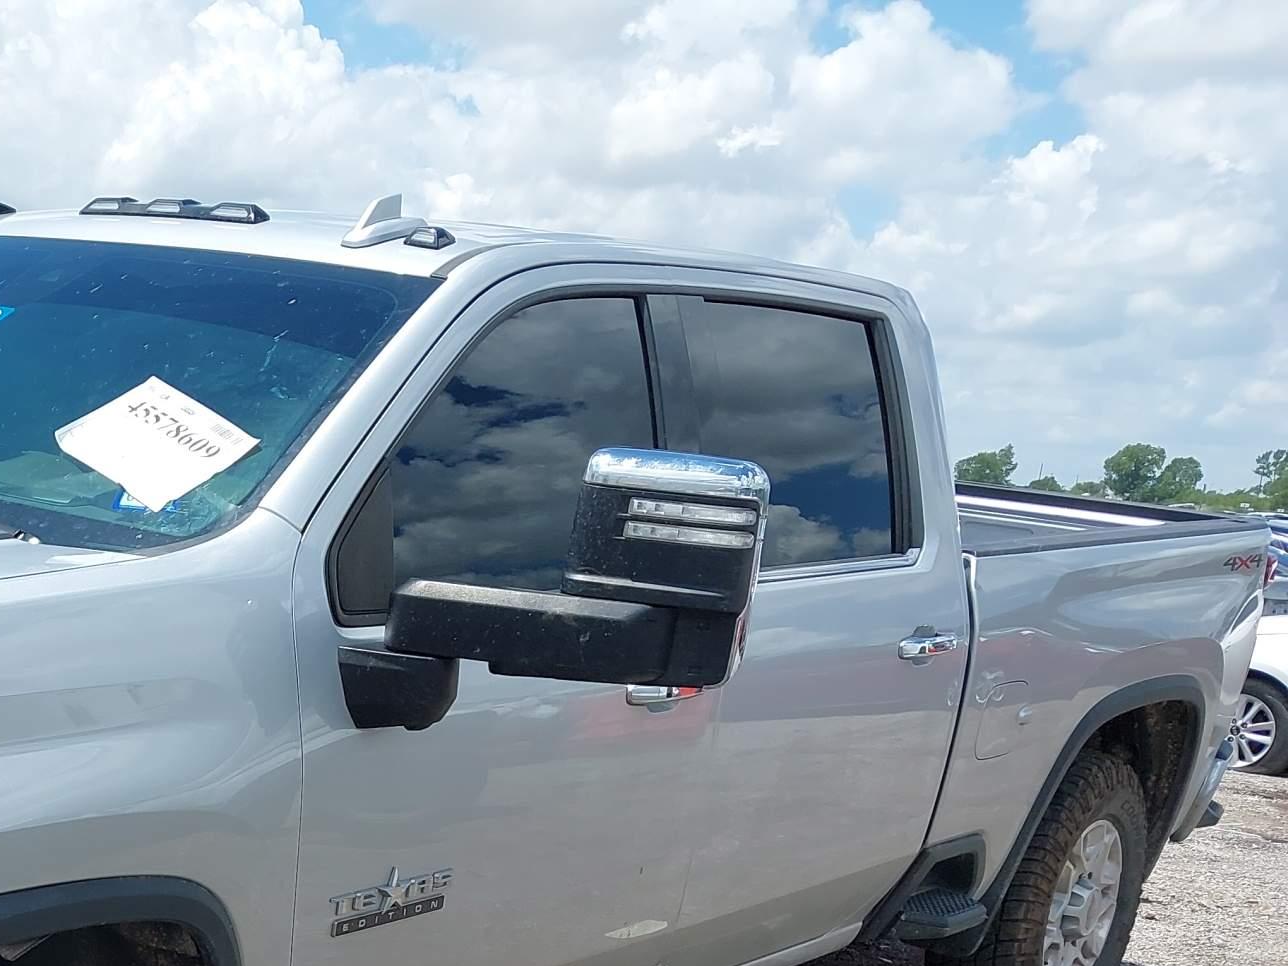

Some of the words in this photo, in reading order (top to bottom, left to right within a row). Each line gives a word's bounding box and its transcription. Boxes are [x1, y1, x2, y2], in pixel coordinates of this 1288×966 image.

[127, 401, 221, 458] 45578609
[329, 867, 454, 916] TEXAS
[342, 901, 440, 932] EDITION
